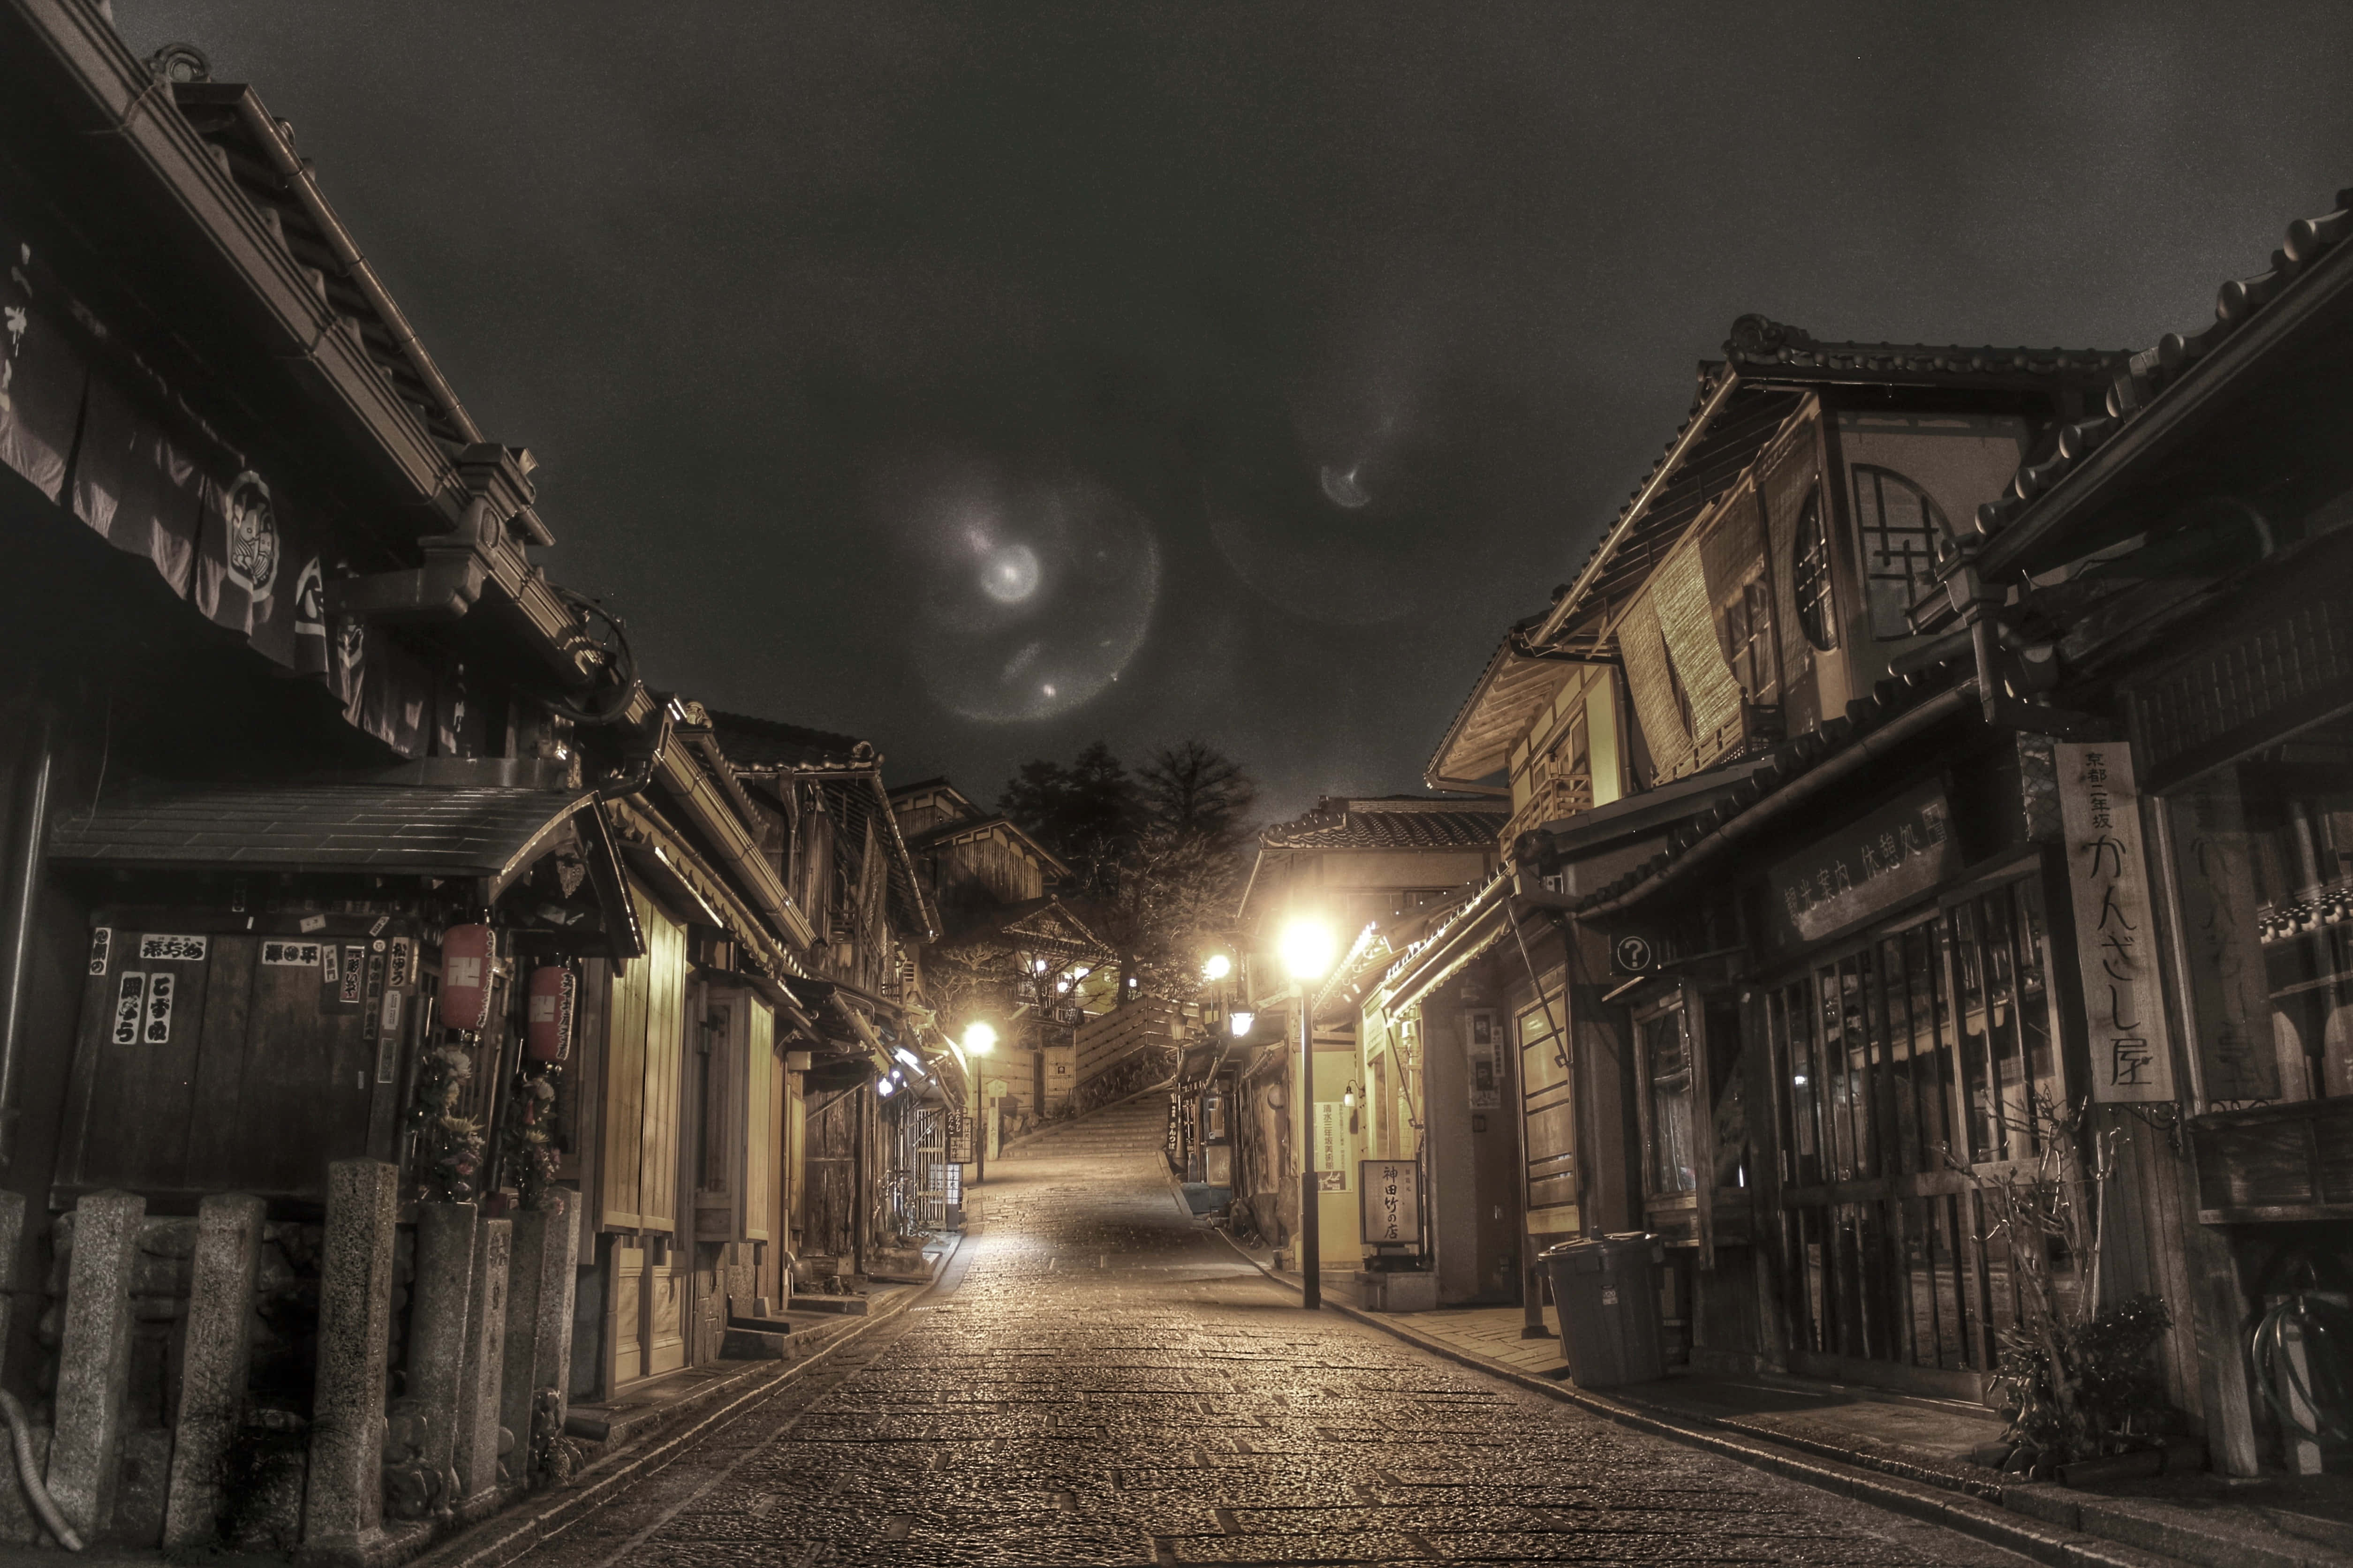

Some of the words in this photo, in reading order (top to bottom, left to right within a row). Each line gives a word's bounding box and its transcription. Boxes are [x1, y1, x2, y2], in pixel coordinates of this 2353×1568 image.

[2085, 752, 2113, 829] 京都二年坂
[1784, 859, 1852, 927] 観光案内
[1861, 822, 1922, 880] 休憩処
[2089, 834, 2153, 1086] かんざし屋
[1323, 1104, 1334, 1170] 清水三年坂美術館
[1382, 1165, 1399, 1239] 神田竹の店
